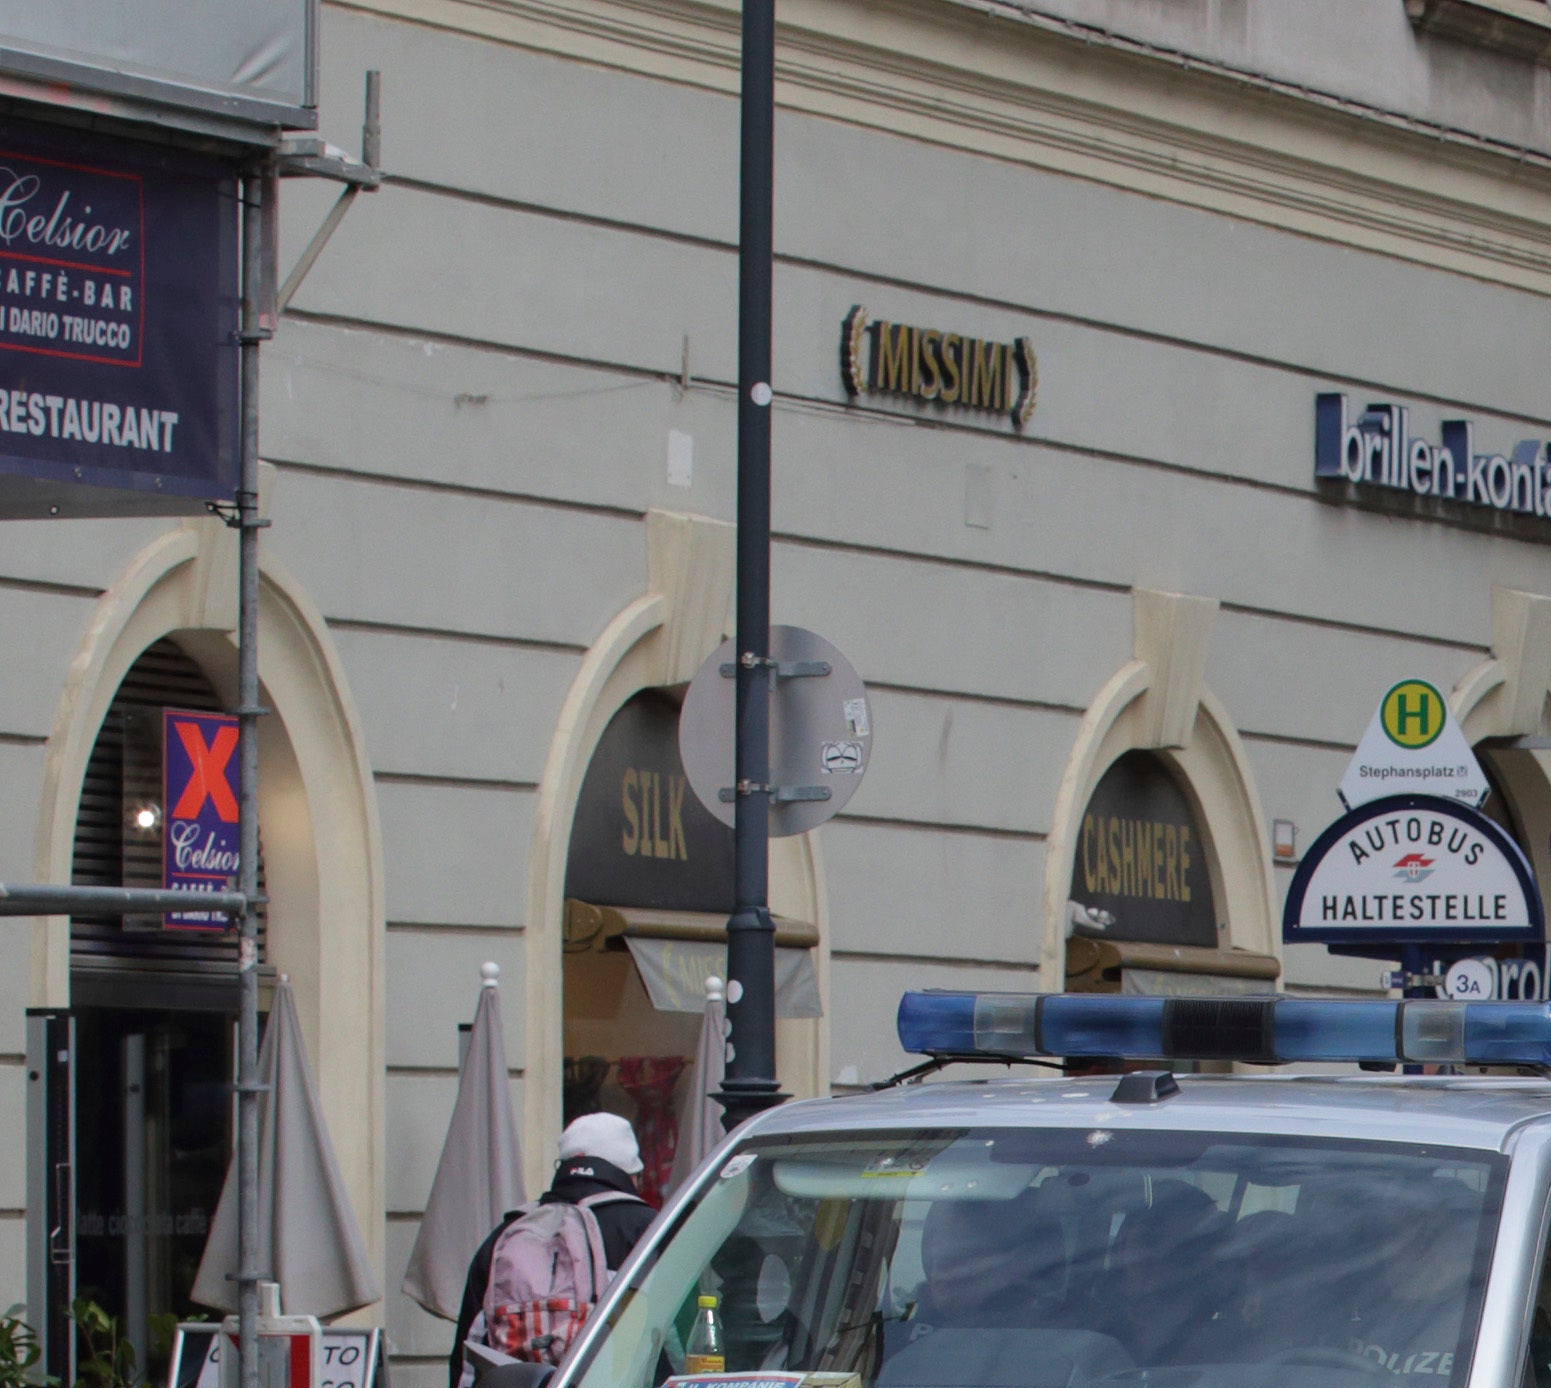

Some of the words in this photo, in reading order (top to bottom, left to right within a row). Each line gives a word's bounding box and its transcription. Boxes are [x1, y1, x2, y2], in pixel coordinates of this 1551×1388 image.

[0, 166, 131, 254] Celsior
[0, 268, 132, 312] AFFÈ-BAR
[9, 307, 59, 339] DARIO
[62, 316, 131, 349] TRUCCO
[876, 320, 1014, 411] MISSIMI
[0, 388, 179, 452] RESTAURANT
[1397, 694, 1429, 735] H
[171, 722, 239, 823] X
[1359, 765, 1454, 780] Stephansplatz
[622, 767, 688, 862] SILK
[1083, 814, 1191, 902] CASHMERE
[1349, 817, 1484, 865] AUTOBUS
[1322, 895, 1507, 920] HALTESTELLE
[1456, 974, 1481, 994] 3A
[324, 1346, 359, 1365] TO
